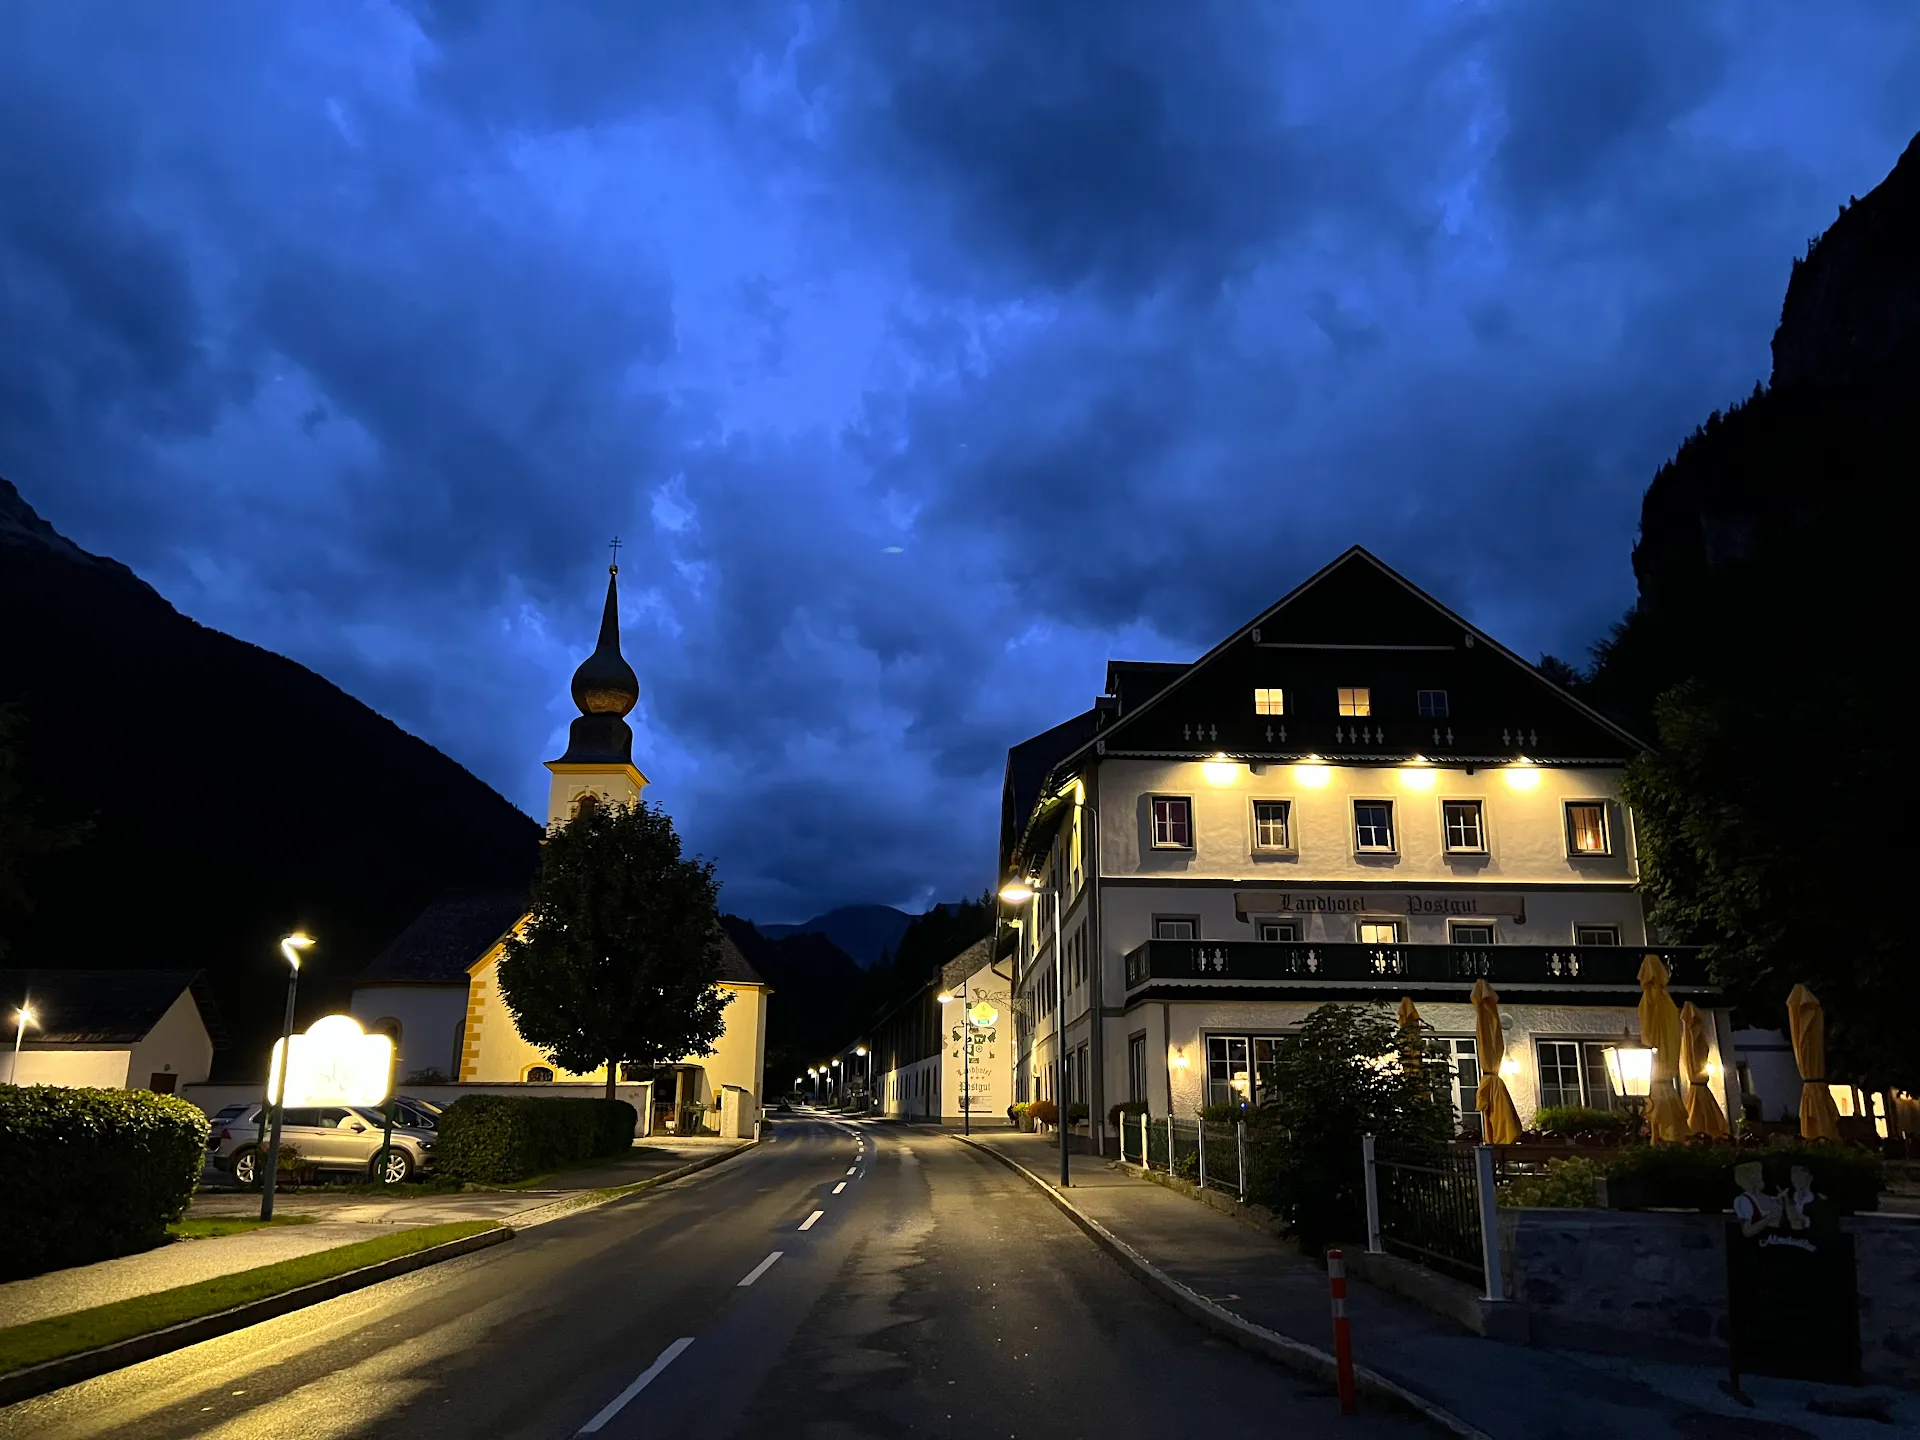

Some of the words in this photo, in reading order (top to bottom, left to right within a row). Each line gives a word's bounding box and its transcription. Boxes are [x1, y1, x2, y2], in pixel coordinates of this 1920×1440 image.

[1280, 893, 1366, 913] Landhotel
[1406, 894, 1478, 914] Postgut
[956, 1066, 992, 1076] Lndhotel
